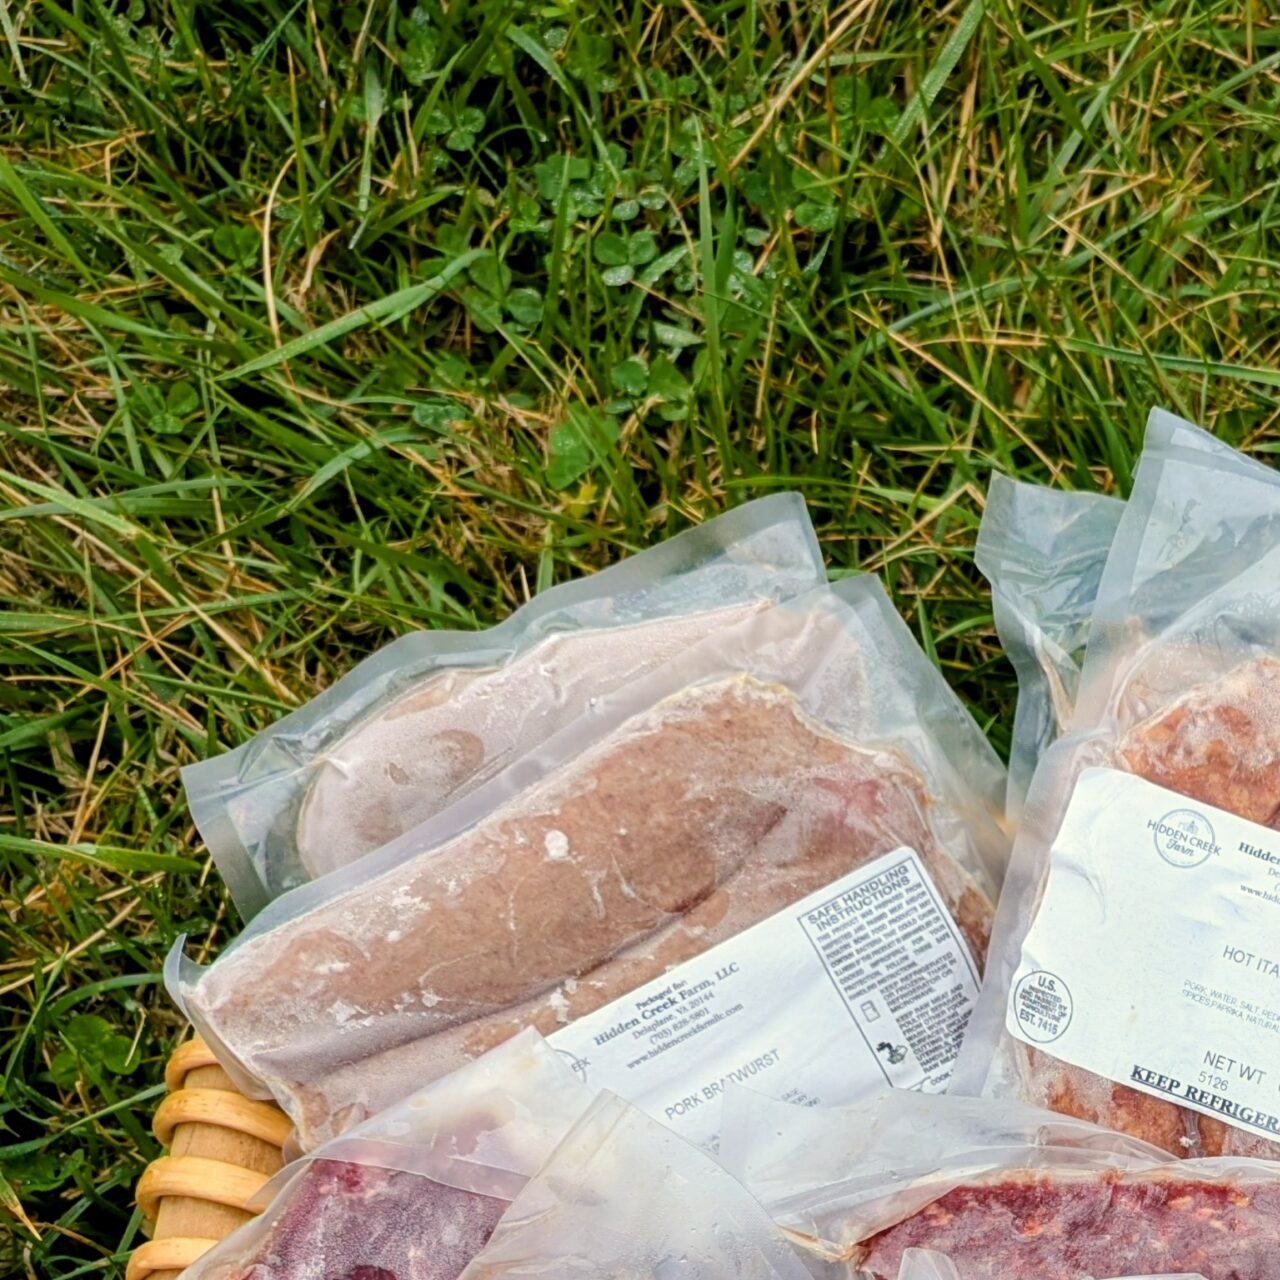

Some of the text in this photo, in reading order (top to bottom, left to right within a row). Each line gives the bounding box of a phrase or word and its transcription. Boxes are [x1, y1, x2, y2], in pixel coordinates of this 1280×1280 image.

[1146, 818, 1222, 856] HIDDEN CREEK
[1165, 837, 1196, 858] Farm
[807, 863, 909, 925] SAFE HANDLING
[816, 874, 911, 932] INSTRUCTIONS
[1222, 945, 1255, 968] HOT
[1036, 975, 1058, 992] U.S.
[593, 961, 740, 1047] Hidden Creek Farm, LLC
[634, 986, 671, 1011] Packaged
[676, 1003, 690, 1017] VA
[570, 1056, 591, 1073] EEK
[1202, 1051, 1236, 1074] NET
[1237, 1063, 1265, 1085] WT
[1130, 1064, 1181, 1095] KEEP
[1197, 1070, 1229, 1092] 5126
[664, 1091, 703, 1121] PORK
